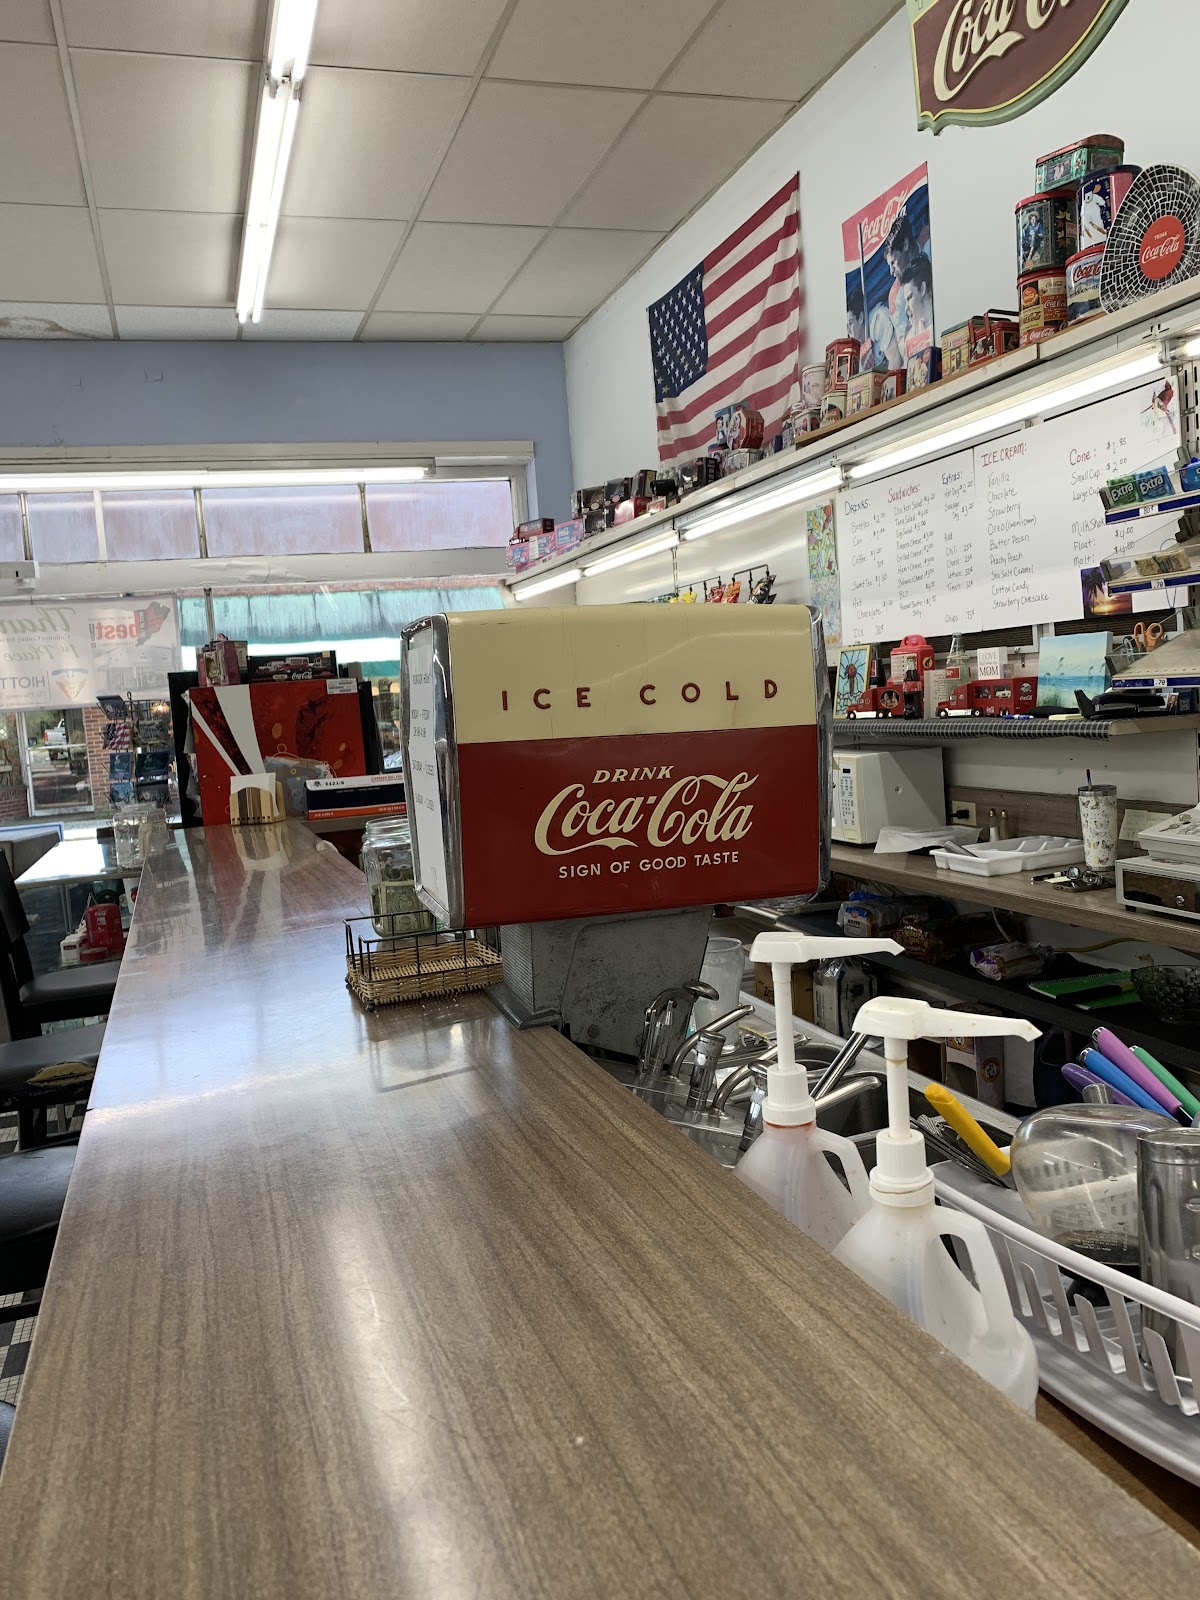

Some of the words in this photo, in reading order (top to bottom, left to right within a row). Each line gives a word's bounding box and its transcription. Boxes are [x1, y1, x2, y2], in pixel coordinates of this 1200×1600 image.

[1142, 234, 1181, 264] Coca-Cola
[981, 451, 999, 467] ICE
[1069, 448, 1097, 466] Cone:
[1106, 436, 1127, 454] $1.85
[942, 470, 963, 485] Extras:
[1071, 471, 1089, 486] Small
[1088, 467, 1104, 481] Cup:
[1106, 457, 1128, 473] $2.00
[988, 472, 1010, 488] Vanilla
[1140, 474, 1163, 496] Extra
[888, 484, 921, 503] Sandwiches:
[988, 488, 1018, 503] Chocolate
[1072, 487, 1090, 503] Large
[1111, 482, 1133, 501] Extra
[987, 501, 1022, 520] Strawberry
[988, 520, 1005, 536] Oreo
[990, 537, 1011, 551] Butter
[1011, 534, 1030, 546] Pecan
[1073, 540, 1097, 553] Float:
[1073, 555, 1097, 569] Malt:
[991, 585, 1011, 596] Cotton
[1012, 580, 1030, 594] Candy
[852, 596, 863, 608] Hot
[992, 597, 1020, 612] Strawberry
[980, 665, 999, 677] MOM
[502, 687, 591, 711] ICE
[639, 679, 778, 706] COLD
[592, 765, 675, 784] DRINK
[534, 772, 759, 856] Coca-Cola
[558, 863, 601, 879] SIGN
[610, 861, 631, 874] OF
[639, 856, 687, 871] GOOD
[694, 851, 740, 866] TASTE
